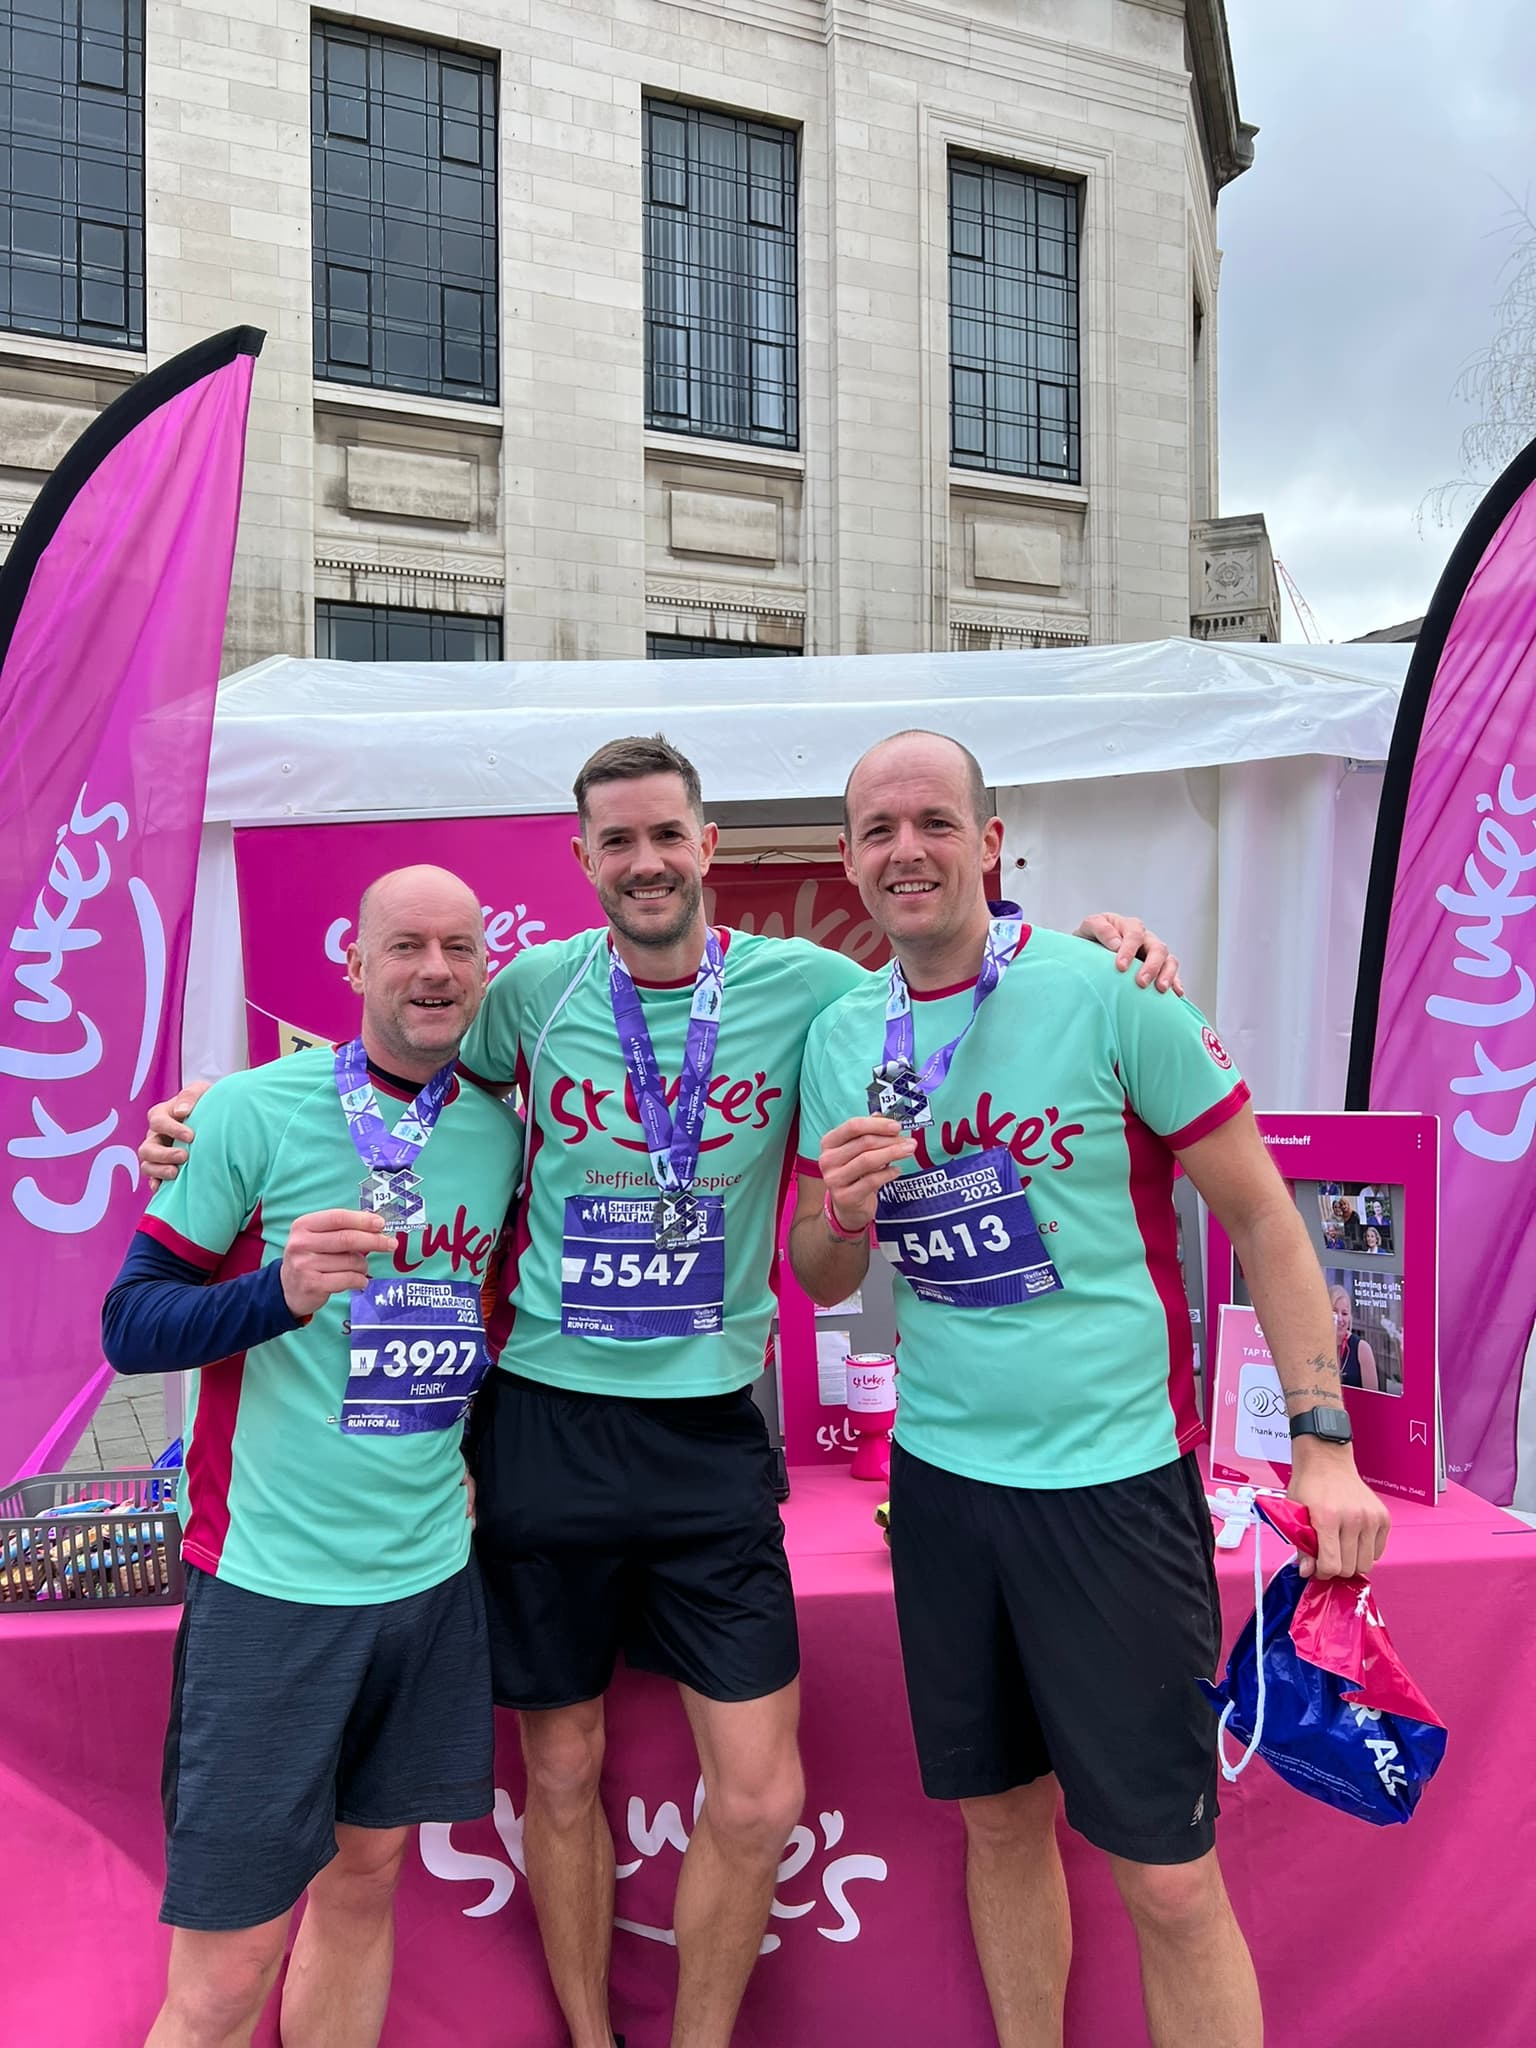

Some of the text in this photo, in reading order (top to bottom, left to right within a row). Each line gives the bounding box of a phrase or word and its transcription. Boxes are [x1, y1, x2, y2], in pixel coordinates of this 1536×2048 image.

[550, 1075, 615, 1145] St
[7, 1096, 140, 1235] St
[692, 1173, 743, 1192] ospice
[895, 1172, 945, 1192] SHEFFIELD
[898, 1167, 996, 1202] HALF MARATHON
[960, 1180, 1002, 1202] 2023
[610, 1202, 654, 1212] SHEFFIEL
[610, 1213, 639, 1223] HALF
[903, 1214, 1011, 1265] 5413
[590, 1253, 700, 1287] 5547
[408, 1285, 451, 1296] SHEFFIELD
[407, 1296, 431, 1307] HALF
[382, 1340, 477, 1378] 3927
[1243, 1347, 1260, 1357] TAP
[360, 1357, 367, 1369] M
[410, 1382, 446, 1396] HENRY
[348, 1420, 400, 1428] RUN FOR ALL
[1250, 1426, 1273, 1437] Thank
[816, 1424, 841, 1452] St
